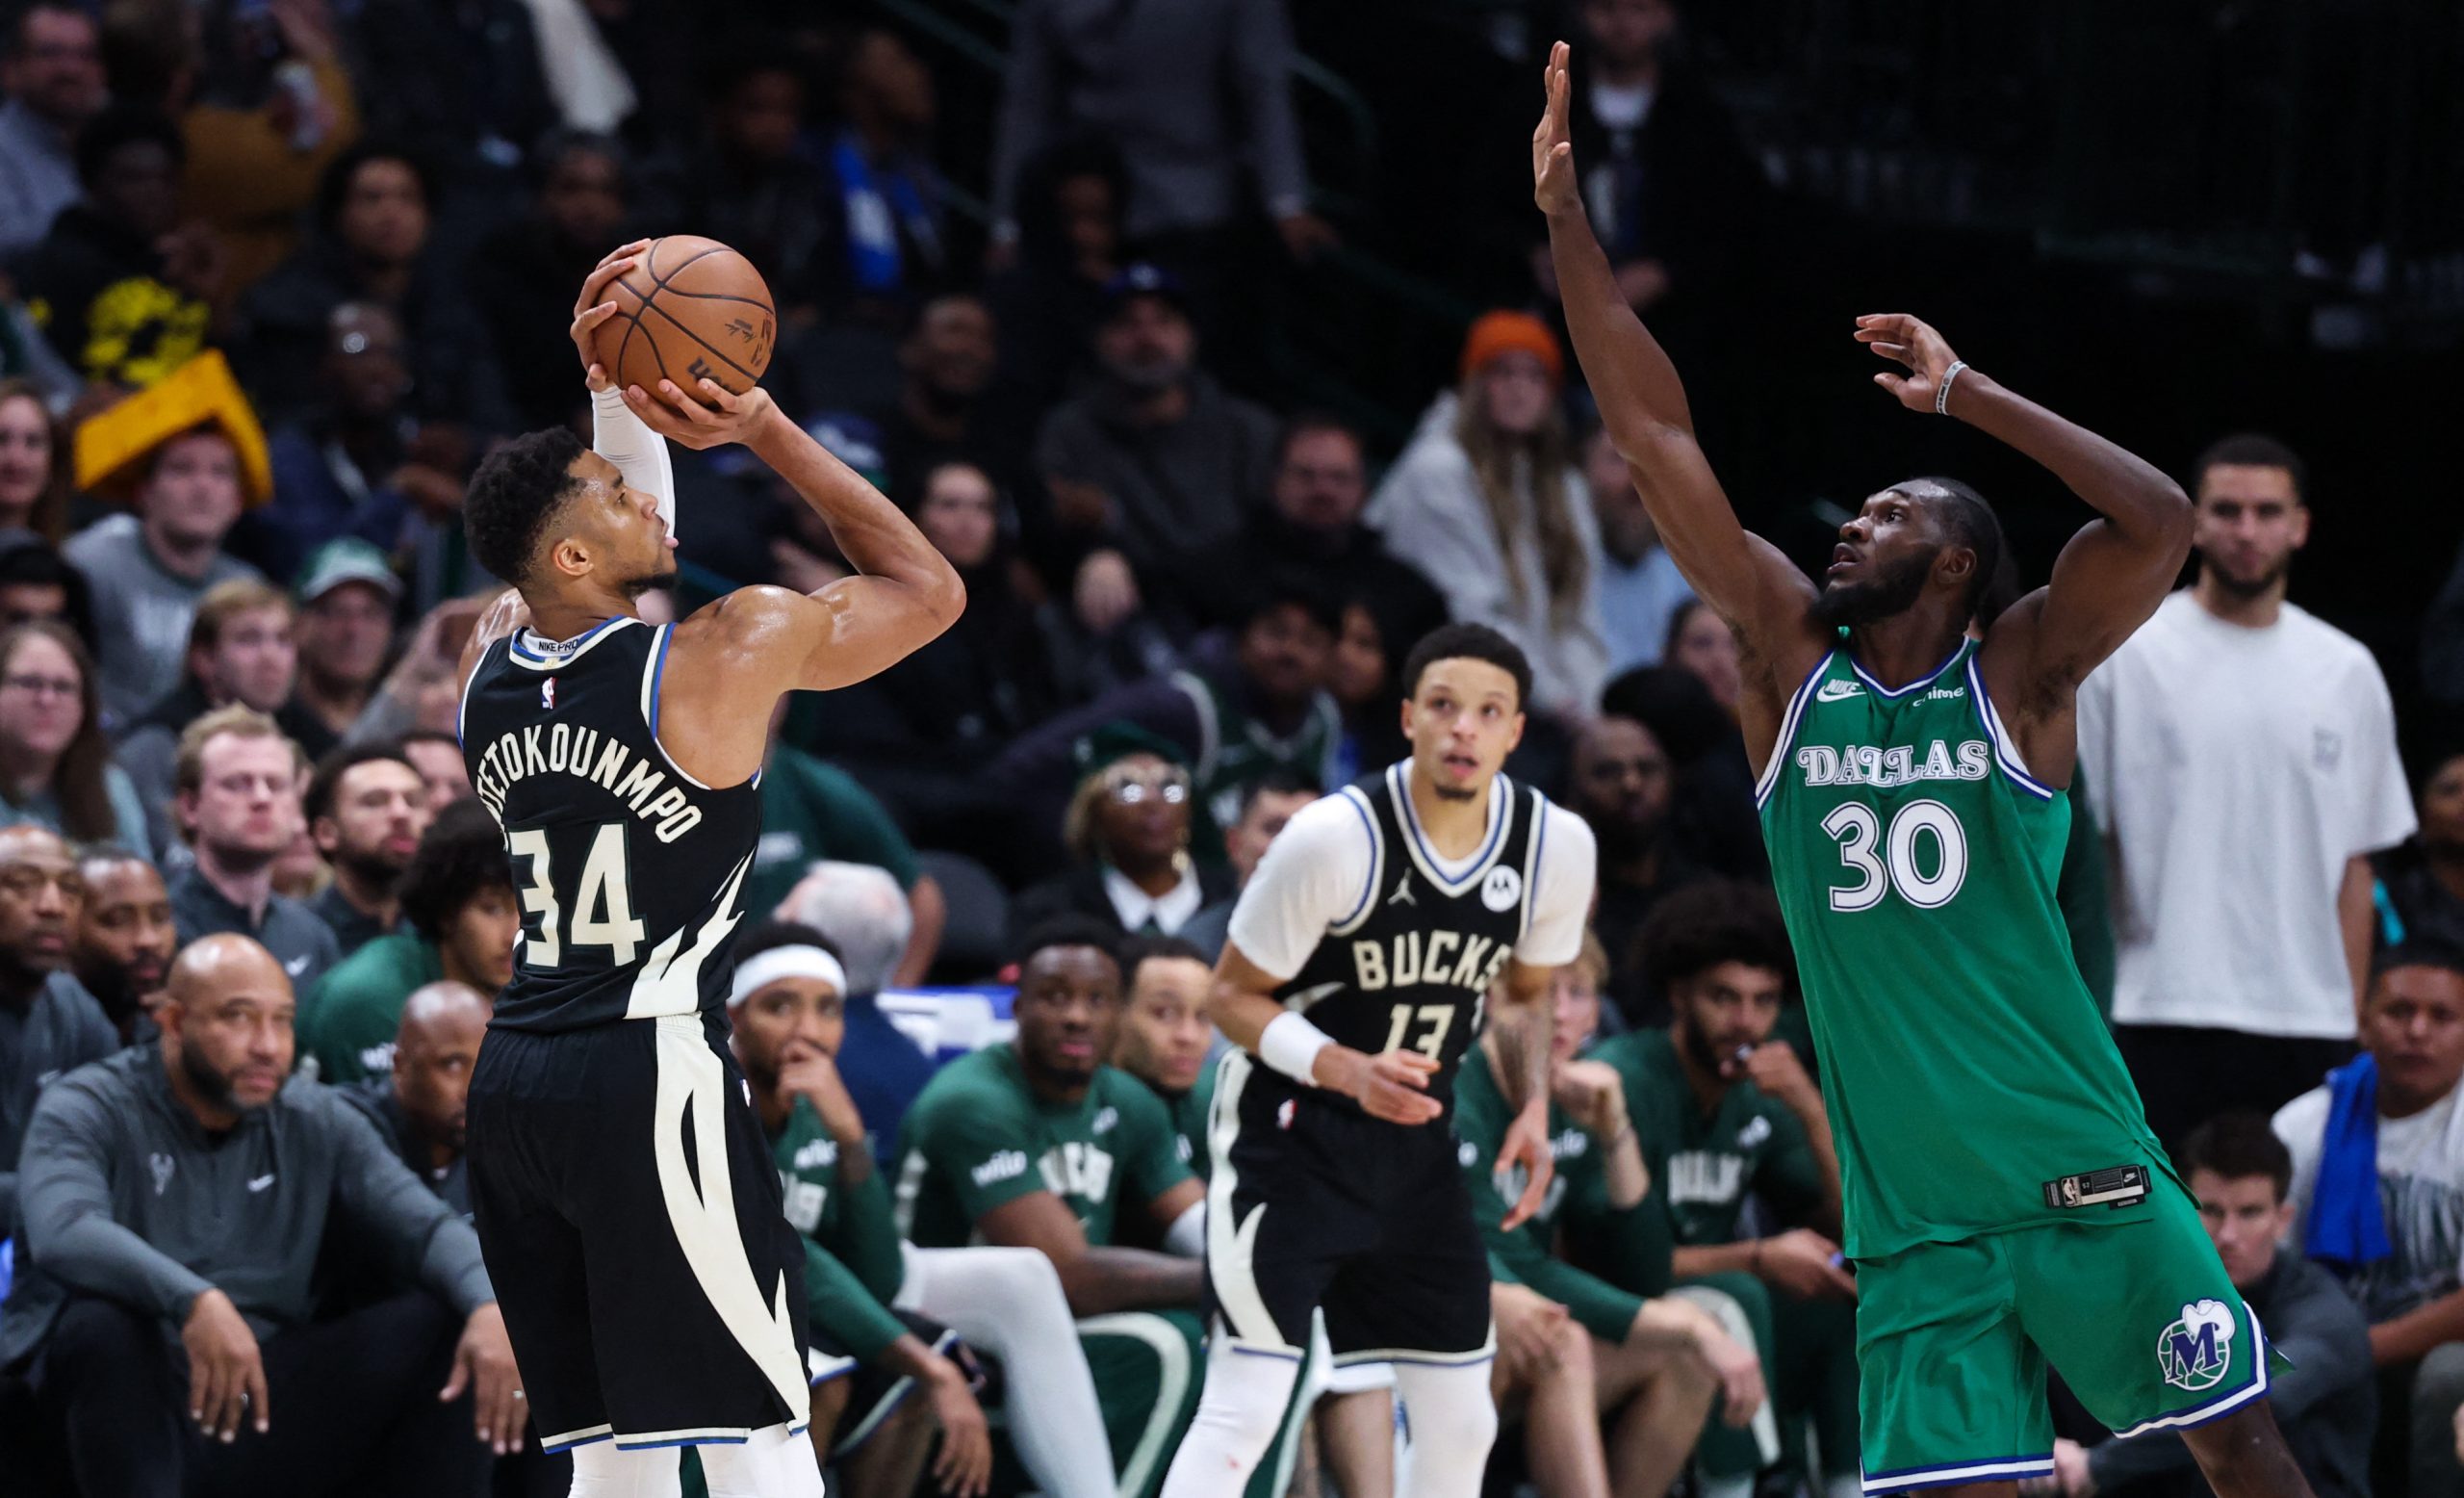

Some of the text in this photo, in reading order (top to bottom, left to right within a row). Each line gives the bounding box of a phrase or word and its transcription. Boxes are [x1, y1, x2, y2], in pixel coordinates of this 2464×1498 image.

[538, 638, 578, 653] NIKE PRO
[1825, 679, 1861, 694] NIKE
[1795, 739, 1990, 788] DALLAS
[1819, 798, 1968, 913] 30
[507, 821, 649, 968] 34
[1383, 1003, 1456, 1063] 13
[2168, 1321, 2223, 1382] M
